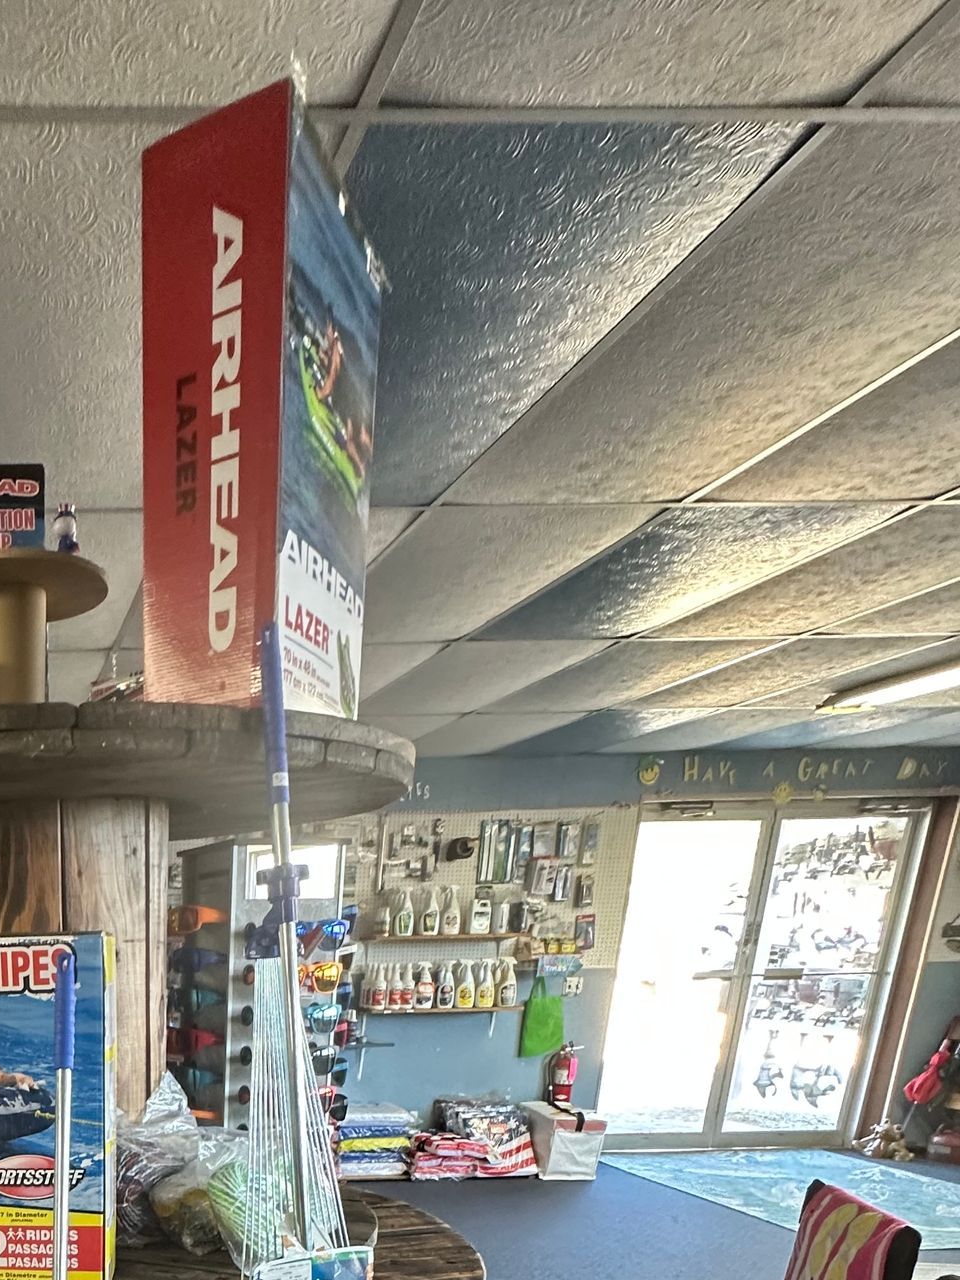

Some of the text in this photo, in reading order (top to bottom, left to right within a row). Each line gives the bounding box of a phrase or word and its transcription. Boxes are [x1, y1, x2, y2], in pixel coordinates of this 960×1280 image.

[176, 371, 197, 518] LAZER
[209, 204, 243, 653] AIRHEAD
[281, 529, 363, 624] AIRHEAD
[285, 595, 329, 655] LAZER
[8, 1243, 78, 1254] PASSAGS
[8, 1257, 79, 1269] PASAJES
[26, 1229, 78, 1241] RIDS
